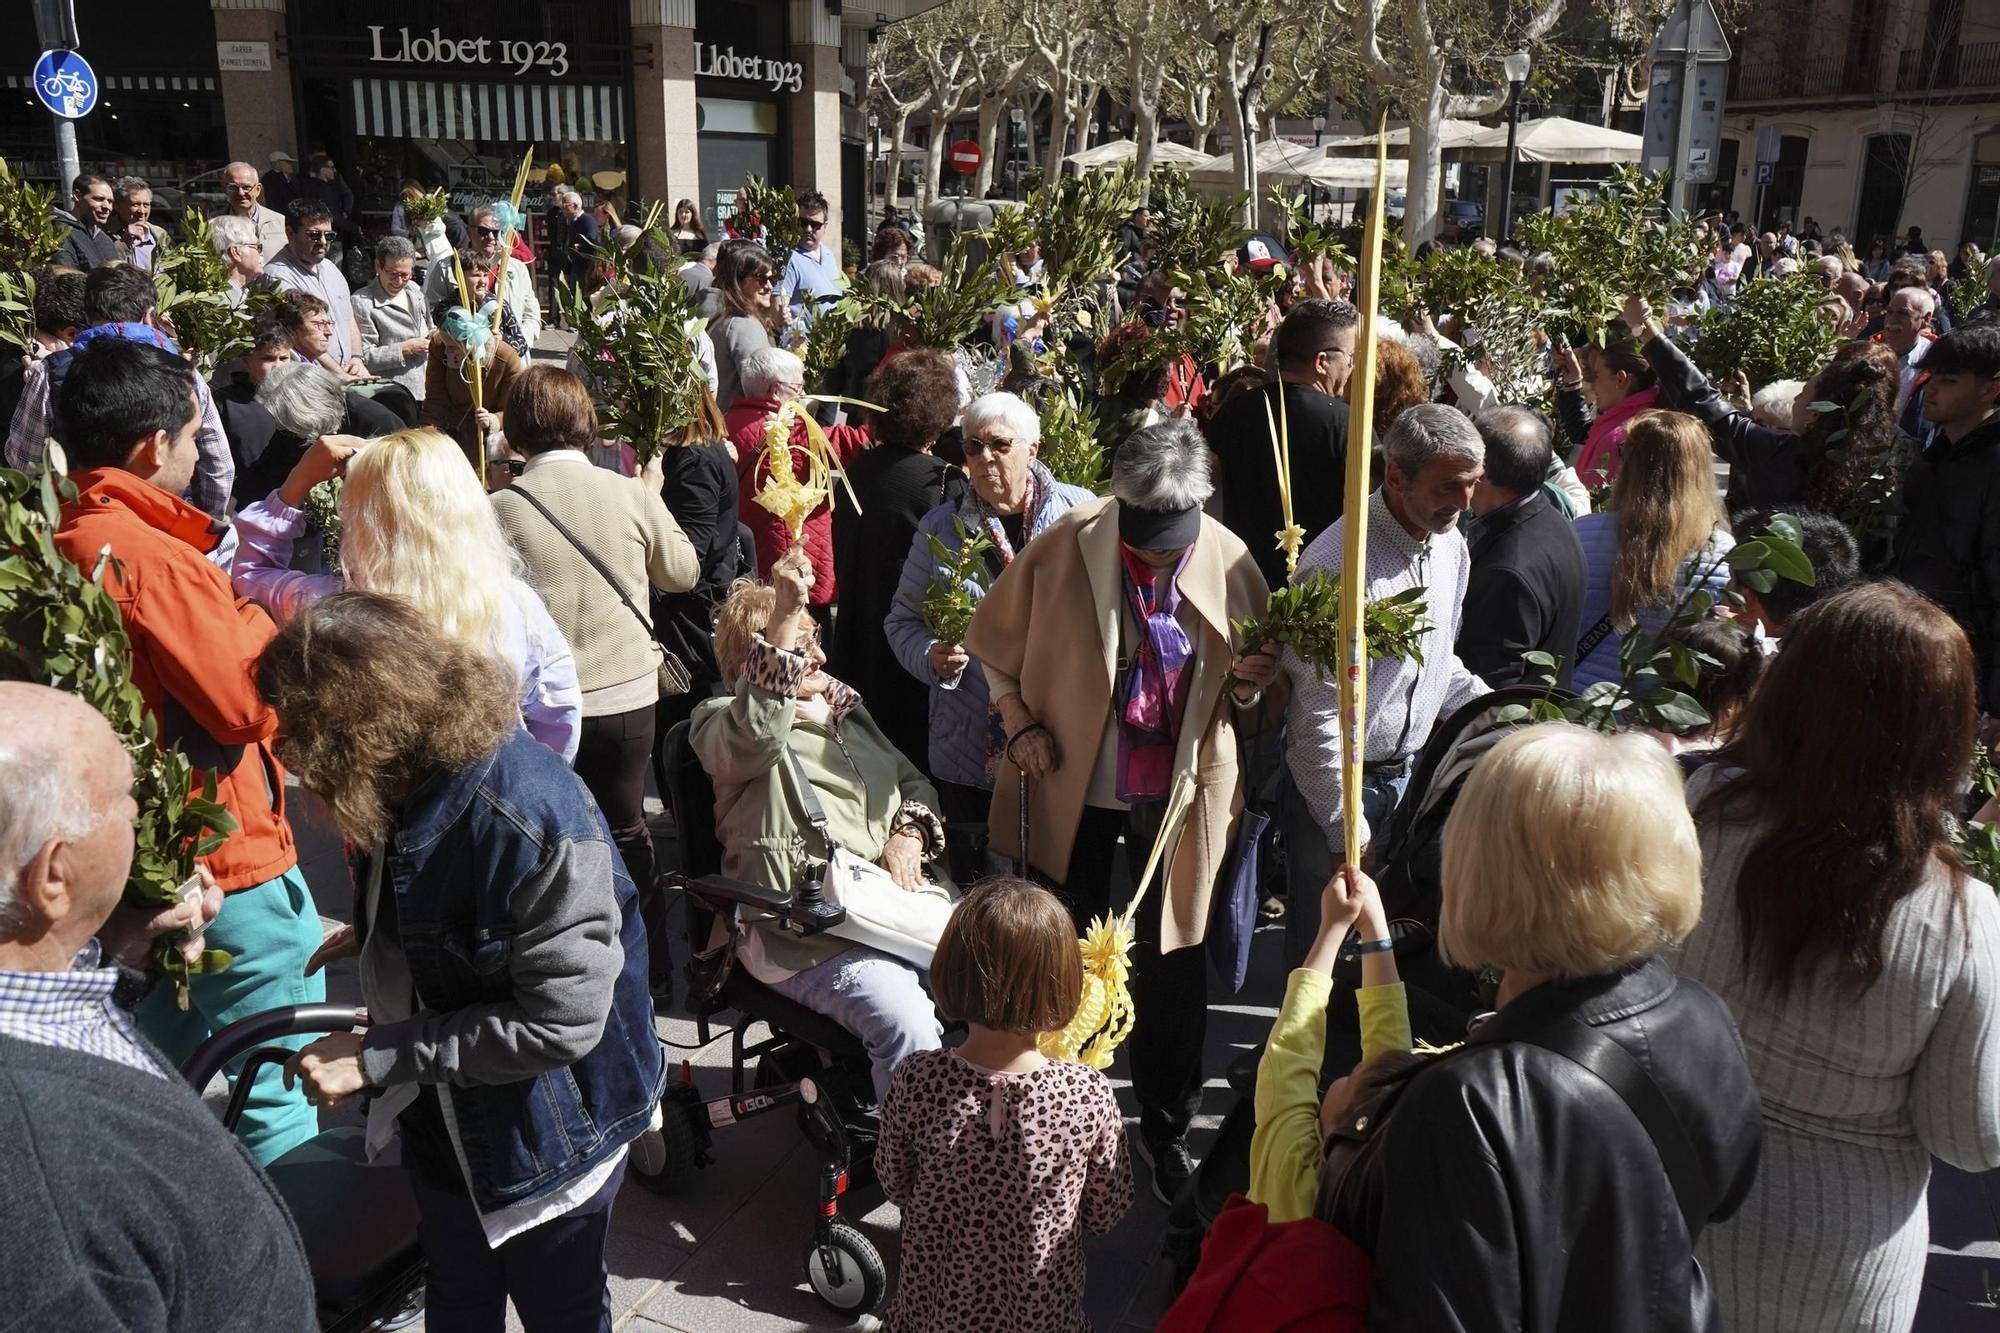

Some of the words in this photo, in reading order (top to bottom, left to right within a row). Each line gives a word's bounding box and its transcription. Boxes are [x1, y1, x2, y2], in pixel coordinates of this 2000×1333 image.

[368, 25, 492, 64] Llobet
[499, 40, 570, 77] 1923
[694, 41, 762, 81] Llobet
[765, 59, 803, 93] 1923
[1758, 165, 1770, 183] P
